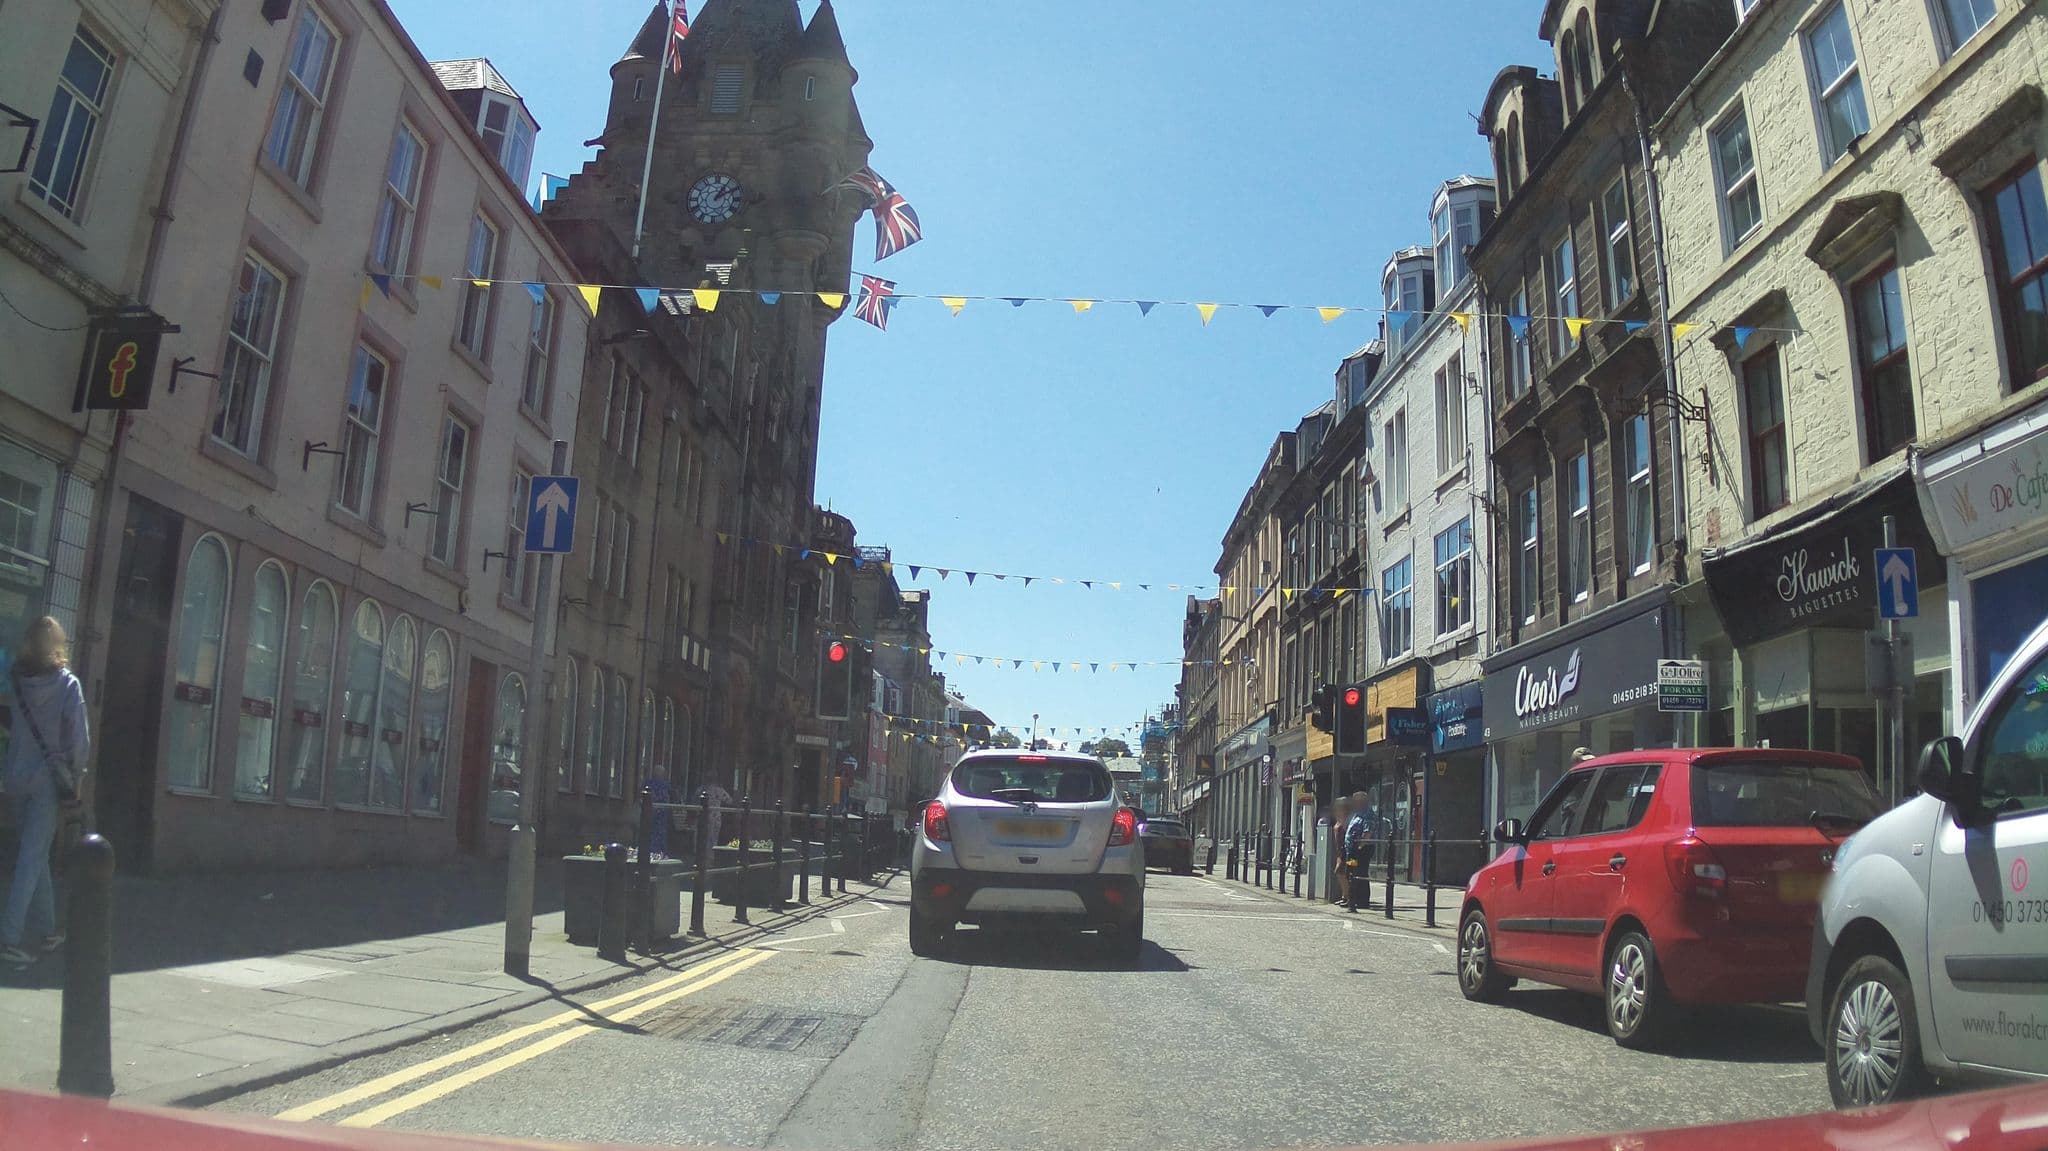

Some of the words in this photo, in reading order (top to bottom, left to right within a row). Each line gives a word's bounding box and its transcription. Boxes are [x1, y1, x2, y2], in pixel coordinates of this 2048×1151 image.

[1990, 483, 2014, 512] De
[1777, 536, 1860, 601] Hawick
[1790, 585, 1859, 618] BAGUETTES
[1514, 665, 1558, 717] Cleo's
[1612, 690, 1634, 706] 01450
[1635, 685, 1648, 700] 218
[1681, 686, 1703, 694] SALE
[1519, 717, 1541, 729] NAILS
[1548, 704, 1581, 722] BEAUTY
[1973, 900, 2013, 923] 01450
